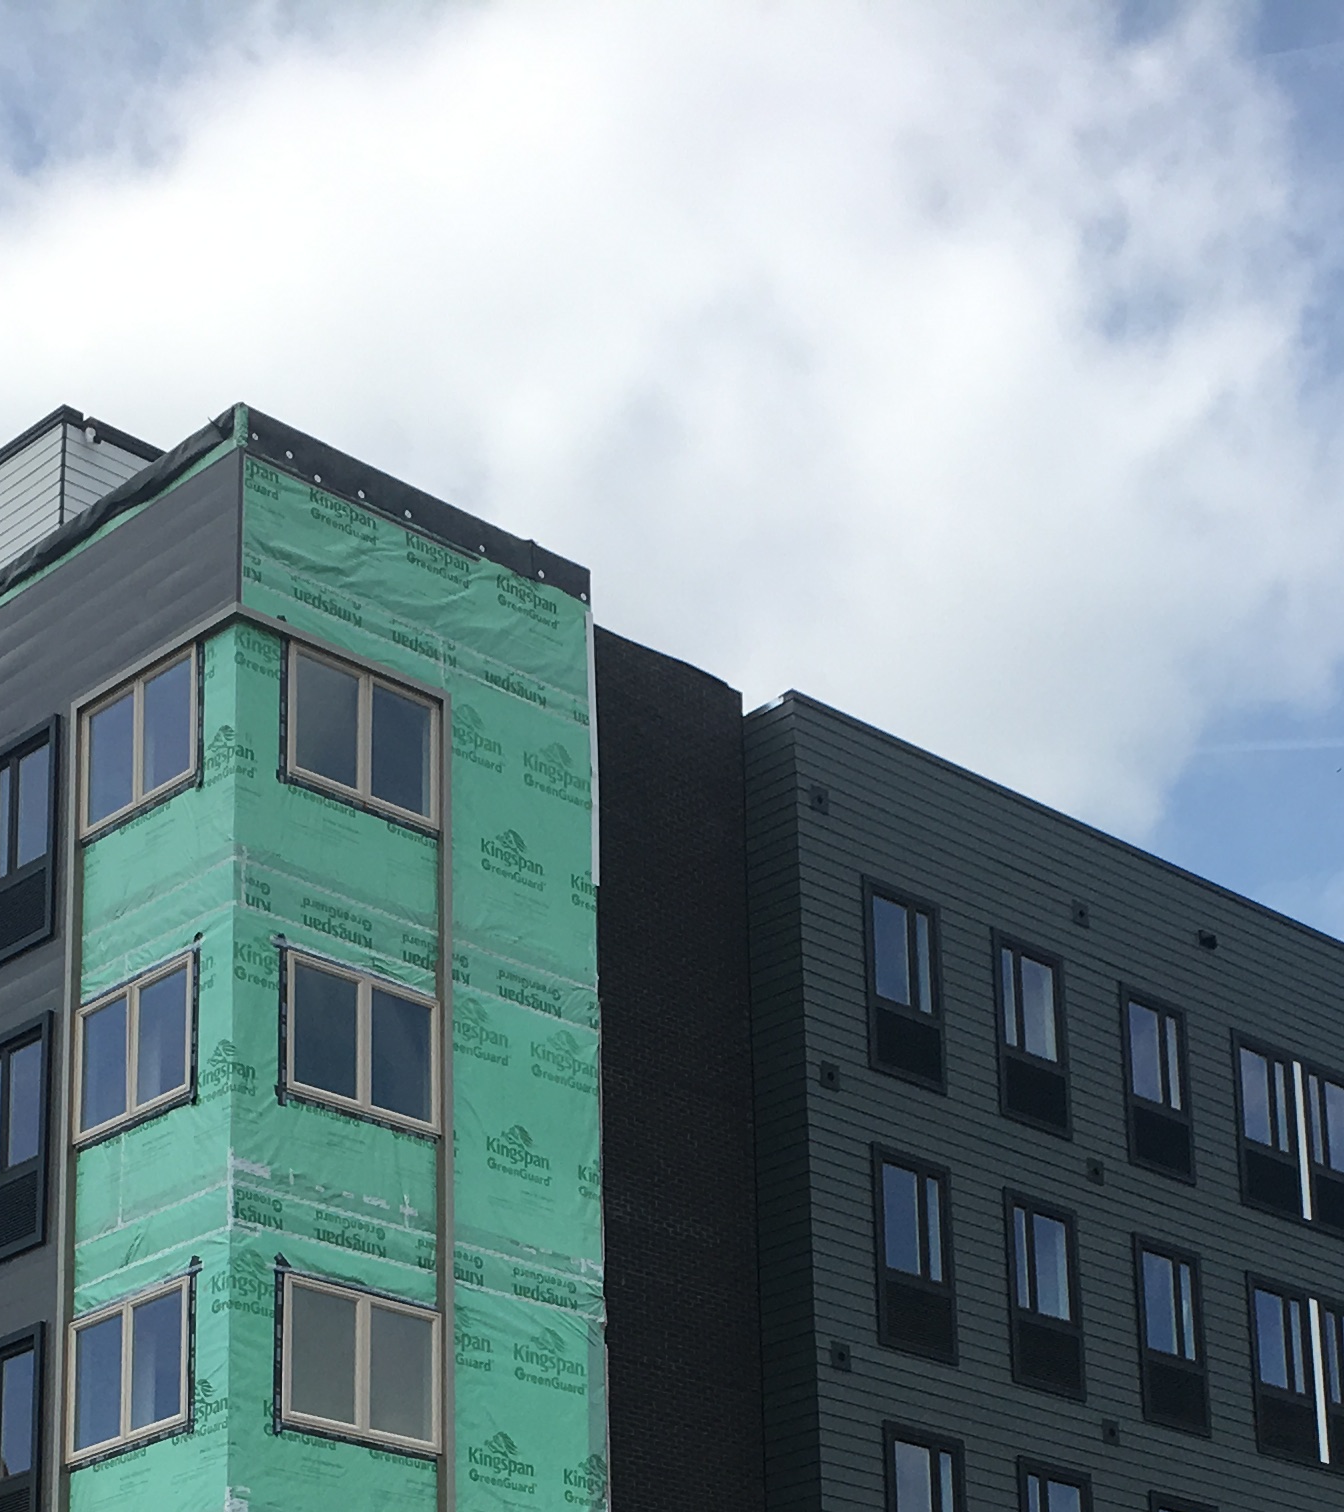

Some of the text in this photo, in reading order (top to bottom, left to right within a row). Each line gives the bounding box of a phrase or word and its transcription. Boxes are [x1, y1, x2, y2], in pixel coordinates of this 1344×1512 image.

[309, 487, 378, 530] Kingspan
[311, 508, 379, 545] GreenGuard
[405, 531, 470, 573] Kingspan
[407, 552, 471, 589] GreenGuard
[497, 573, 558, 614] Kingspan
[497, 595, 559, 630] GreenGuard
[234, 630, 280, 665] Kings
[204, 743, 256, 771] ingspan
[452, 726, 504, 757] ngspan
[523, 751, 591, 794] Kingspan
[524, 773, 592, 811] GreenGuard
[386, 822, 437, 849] GreenGu
[481, 837, 545, 877] Kingspan
[482, 858, 546, 892] GreenGuard
[233, 941, 280, 977] Kings
[453, 1020, 509, 1049] ngspan
[530, 1041, 598, 1080] Kingspan
[531, 1064, 599, 1096] GreenGuard
[486, 1137, 551, 1171] Kingspan
[487, 1158, 552, 1187] GreenGuard
[210, 1273, 275, 1301] Kingspa
[210, 1299, 275, 1319] GreenGua
[513, 1343, 586, 1378] Kingspan
[514, 1366, 587, 1396] GreenGuard
[468, 1447, 535, 1477] Kingspan
[469, 1468, 537, 1495] GreenGuard
[563, 1468, 607, 1494] Kingsp
